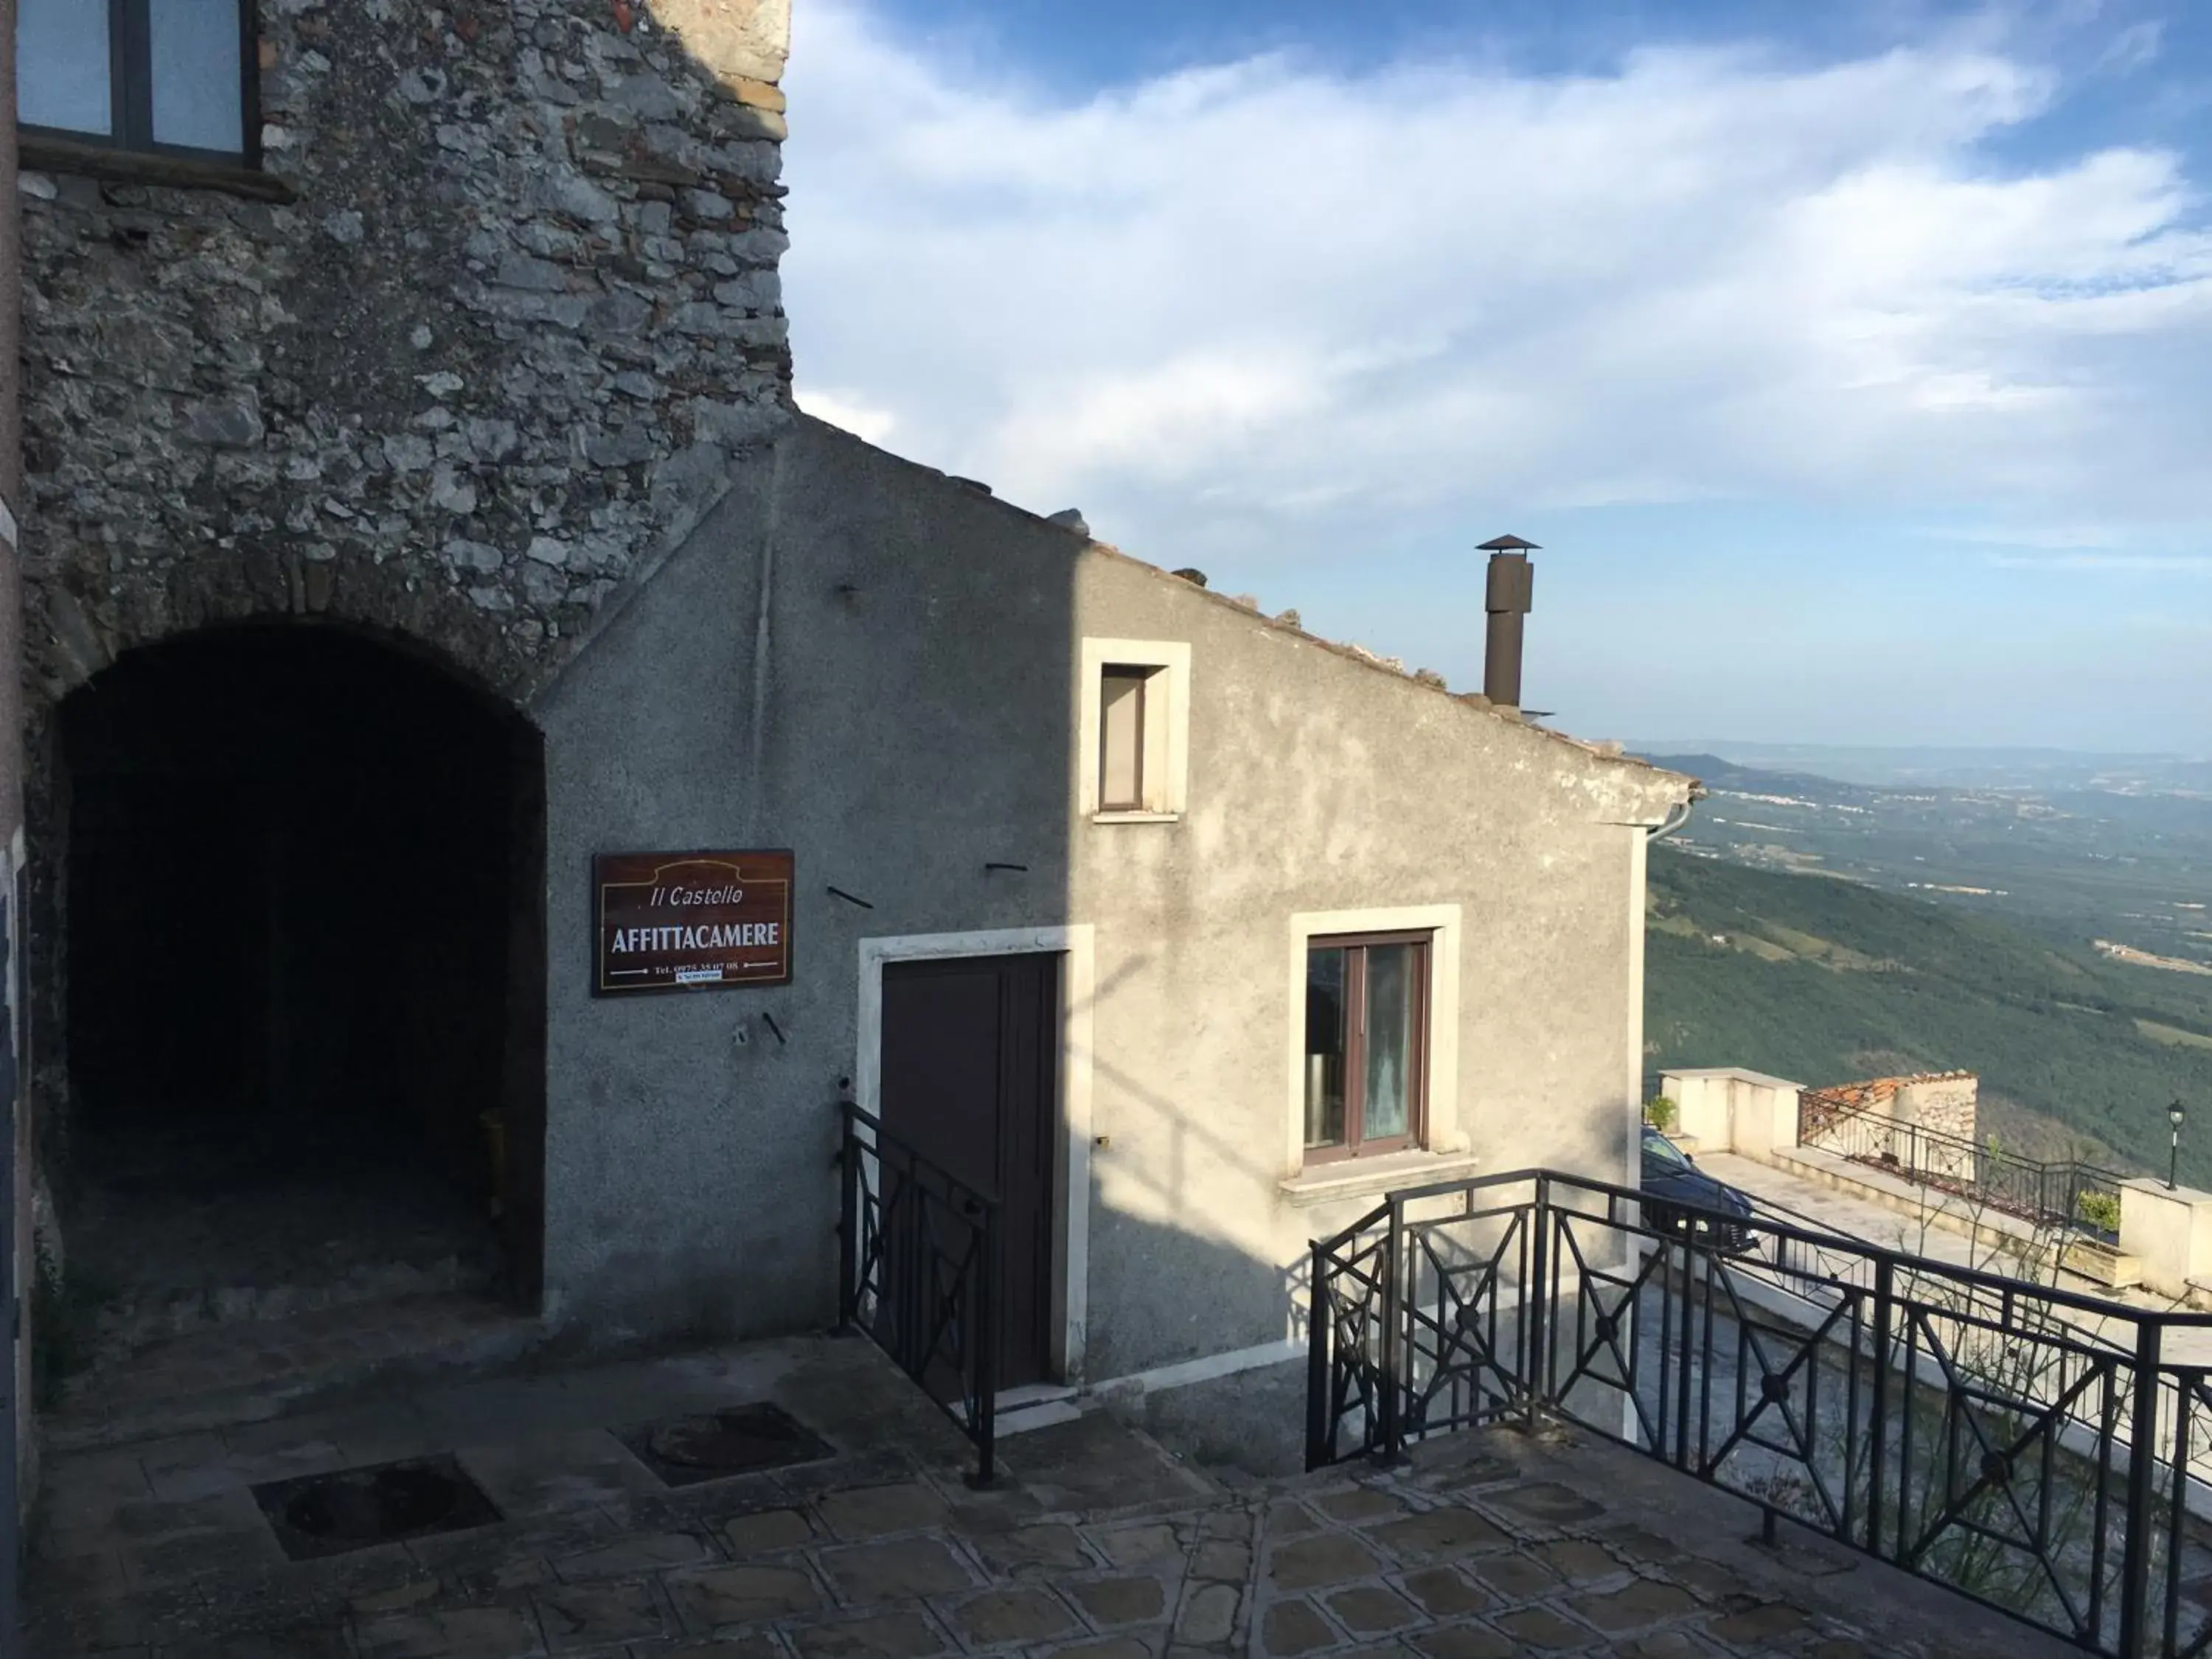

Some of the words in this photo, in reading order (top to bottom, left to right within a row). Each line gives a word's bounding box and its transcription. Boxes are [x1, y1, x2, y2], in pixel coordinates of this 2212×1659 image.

[650, 887, 664, 906] Il
[669, 885, 743, 905] Castello
[611, 922, 779, 953] AFFITTACAMERE
